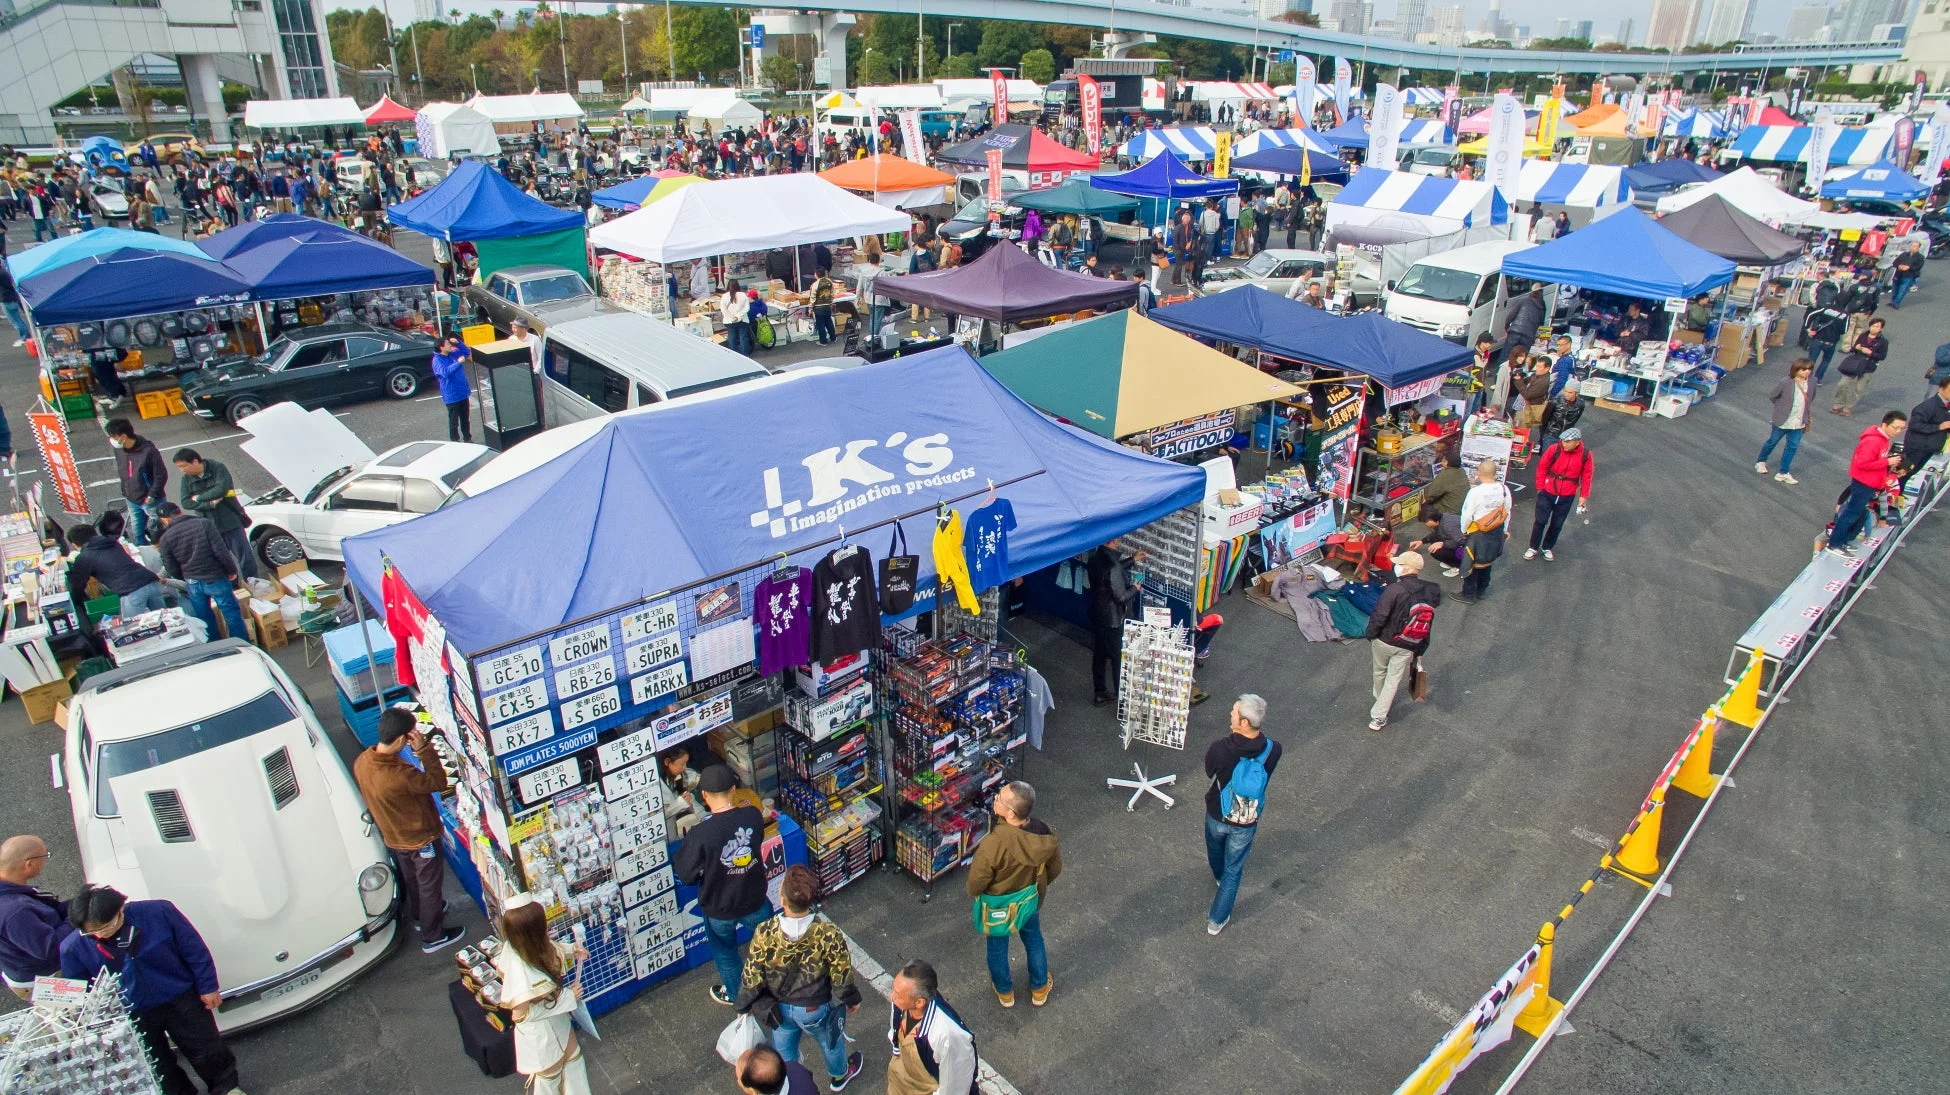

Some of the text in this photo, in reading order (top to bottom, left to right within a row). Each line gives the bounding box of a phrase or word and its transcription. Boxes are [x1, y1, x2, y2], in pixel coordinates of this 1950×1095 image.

[1327, 386, 1352, 404] Used
[790, 466, 976, 532] Imagination products
[644, 613, 675, 633] C-HR
[564, 636, 608, 662] CROWN
[640, 642, 680, 668] SUPRA
[494, 658, 540, 685] GC-10
[570, 668, 612, 693] RB-26
[645, 672, 685, 698] MARKX
[500, 694, 533, 718] CX-5
[507, 726, 540, 750] RX-7
[558, 735, 594, 754] 5000YEN
[621, 739, 652, 762] R-34
[535, 774, 568, 797] GT-R
[628, 769, 656, 790] 1-JZ
[631, 796, 660, 817] S-13
[635, 823, 663, 846] R-32
[637, 851, 665, 870] R-33
[639, 900, 674, 925] BE-NZ
[646, 930, 673, 949] AM-G
[648, 947, 682, 972] MO-VE
